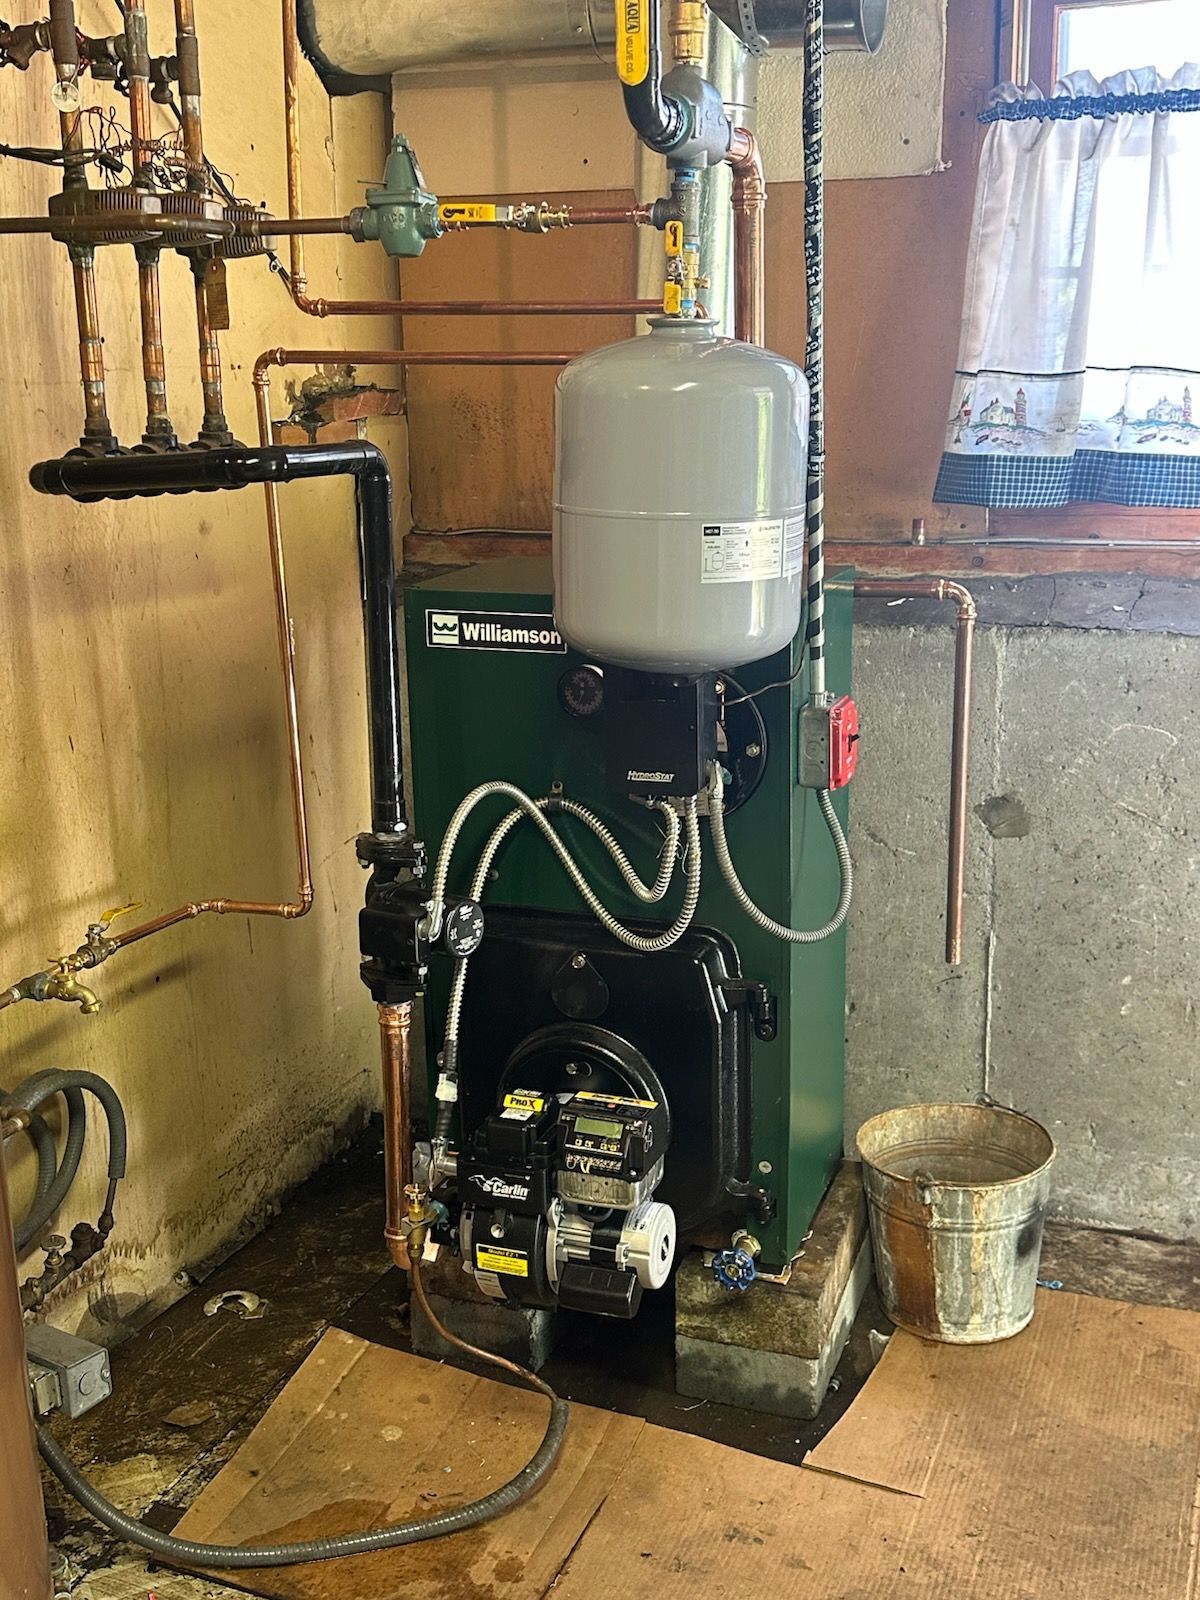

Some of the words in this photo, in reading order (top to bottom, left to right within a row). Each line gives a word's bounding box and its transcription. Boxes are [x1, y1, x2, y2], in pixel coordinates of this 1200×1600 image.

[627, 2, 639, 31] AQUA
[462, 622, 562, 645] Williamson
[492, 1181, 529, 1197] Carlin
